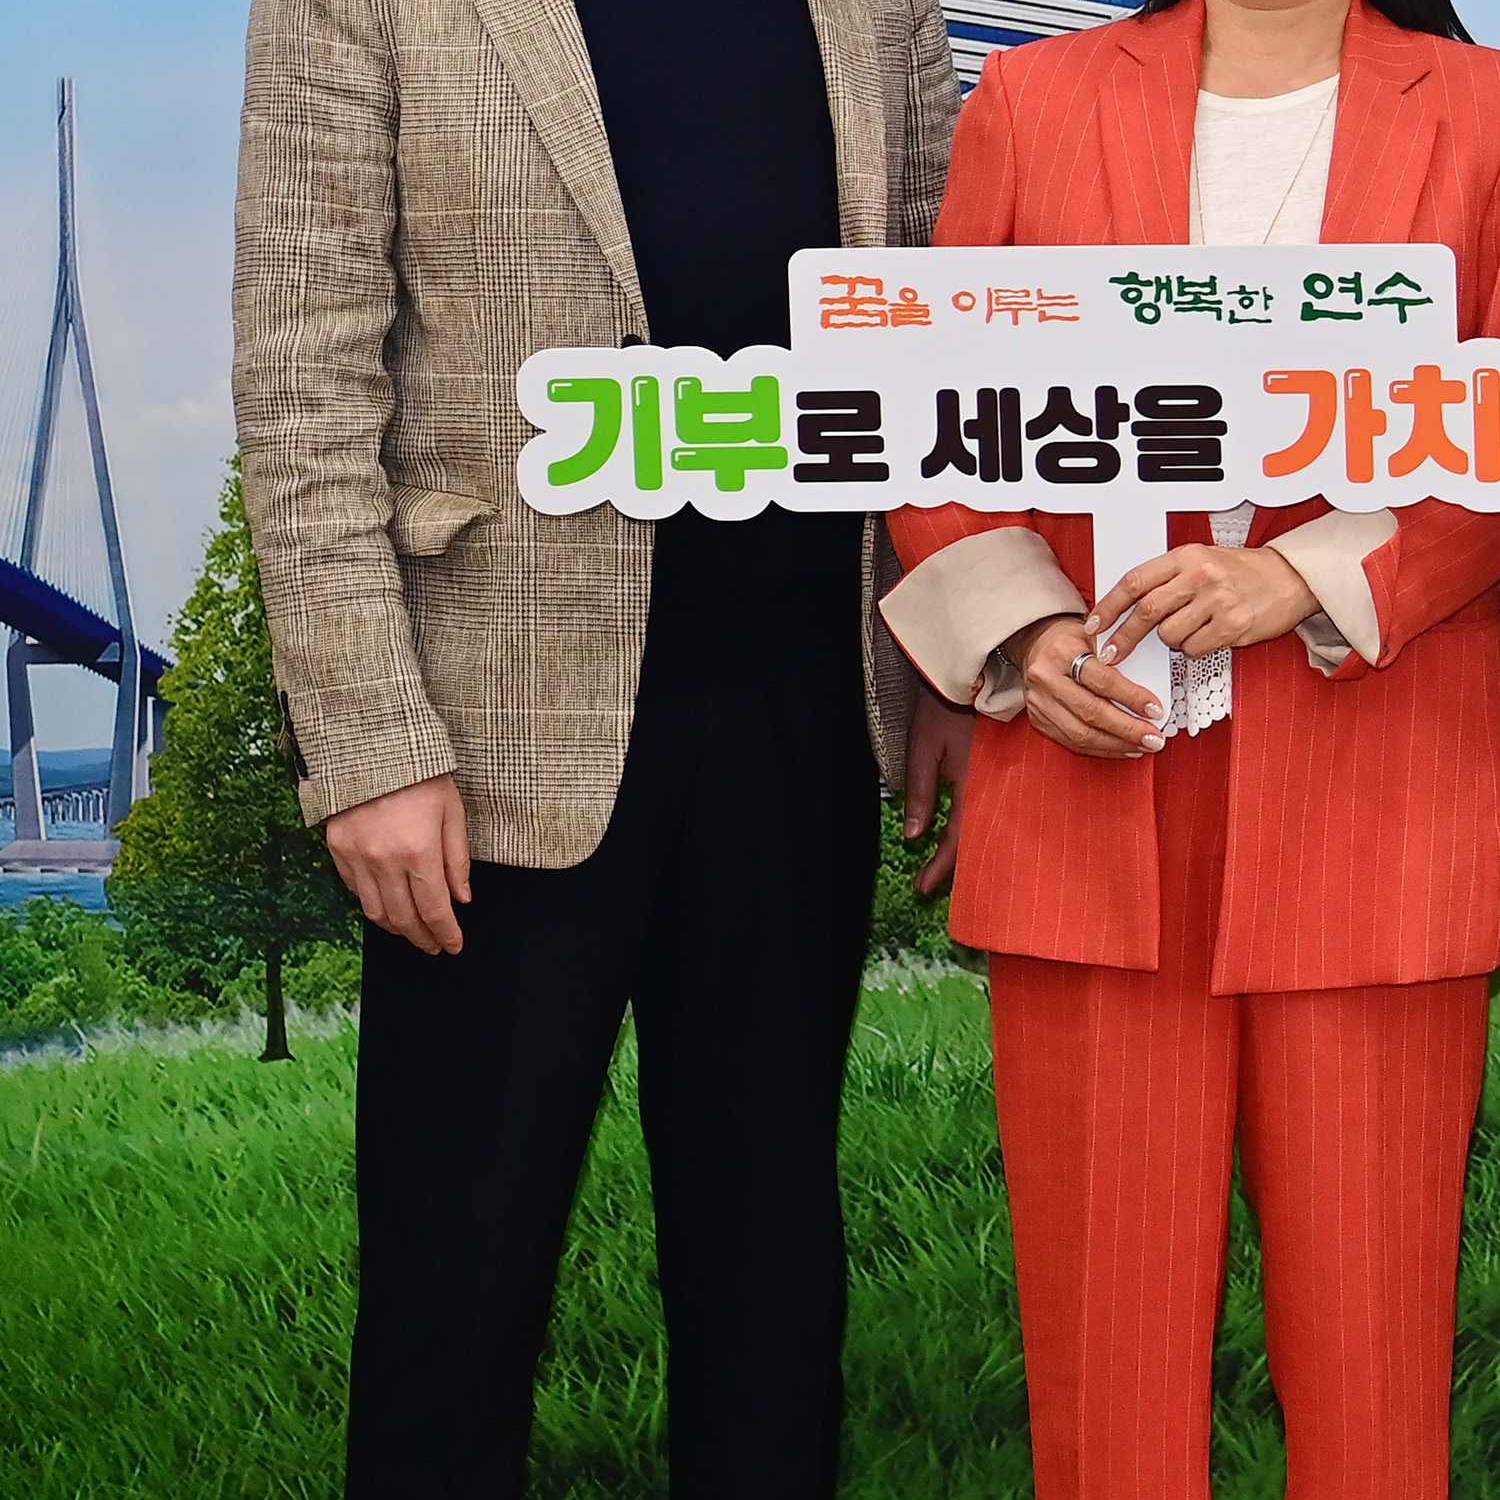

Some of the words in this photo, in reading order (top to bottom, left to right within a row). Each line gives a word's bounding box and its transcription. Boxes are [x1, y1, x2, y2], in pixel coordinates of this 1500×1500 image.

[819, 273, 933, 329] 꿈을
[950, 286, 1081, 326] 이루는
[1108, 271, 1274, 325] 행복한
[1300, 271, 1435, 325] 연수
[546, 373, 890, 493] 기부로
[921, 383, 1229, 483] 세상을
